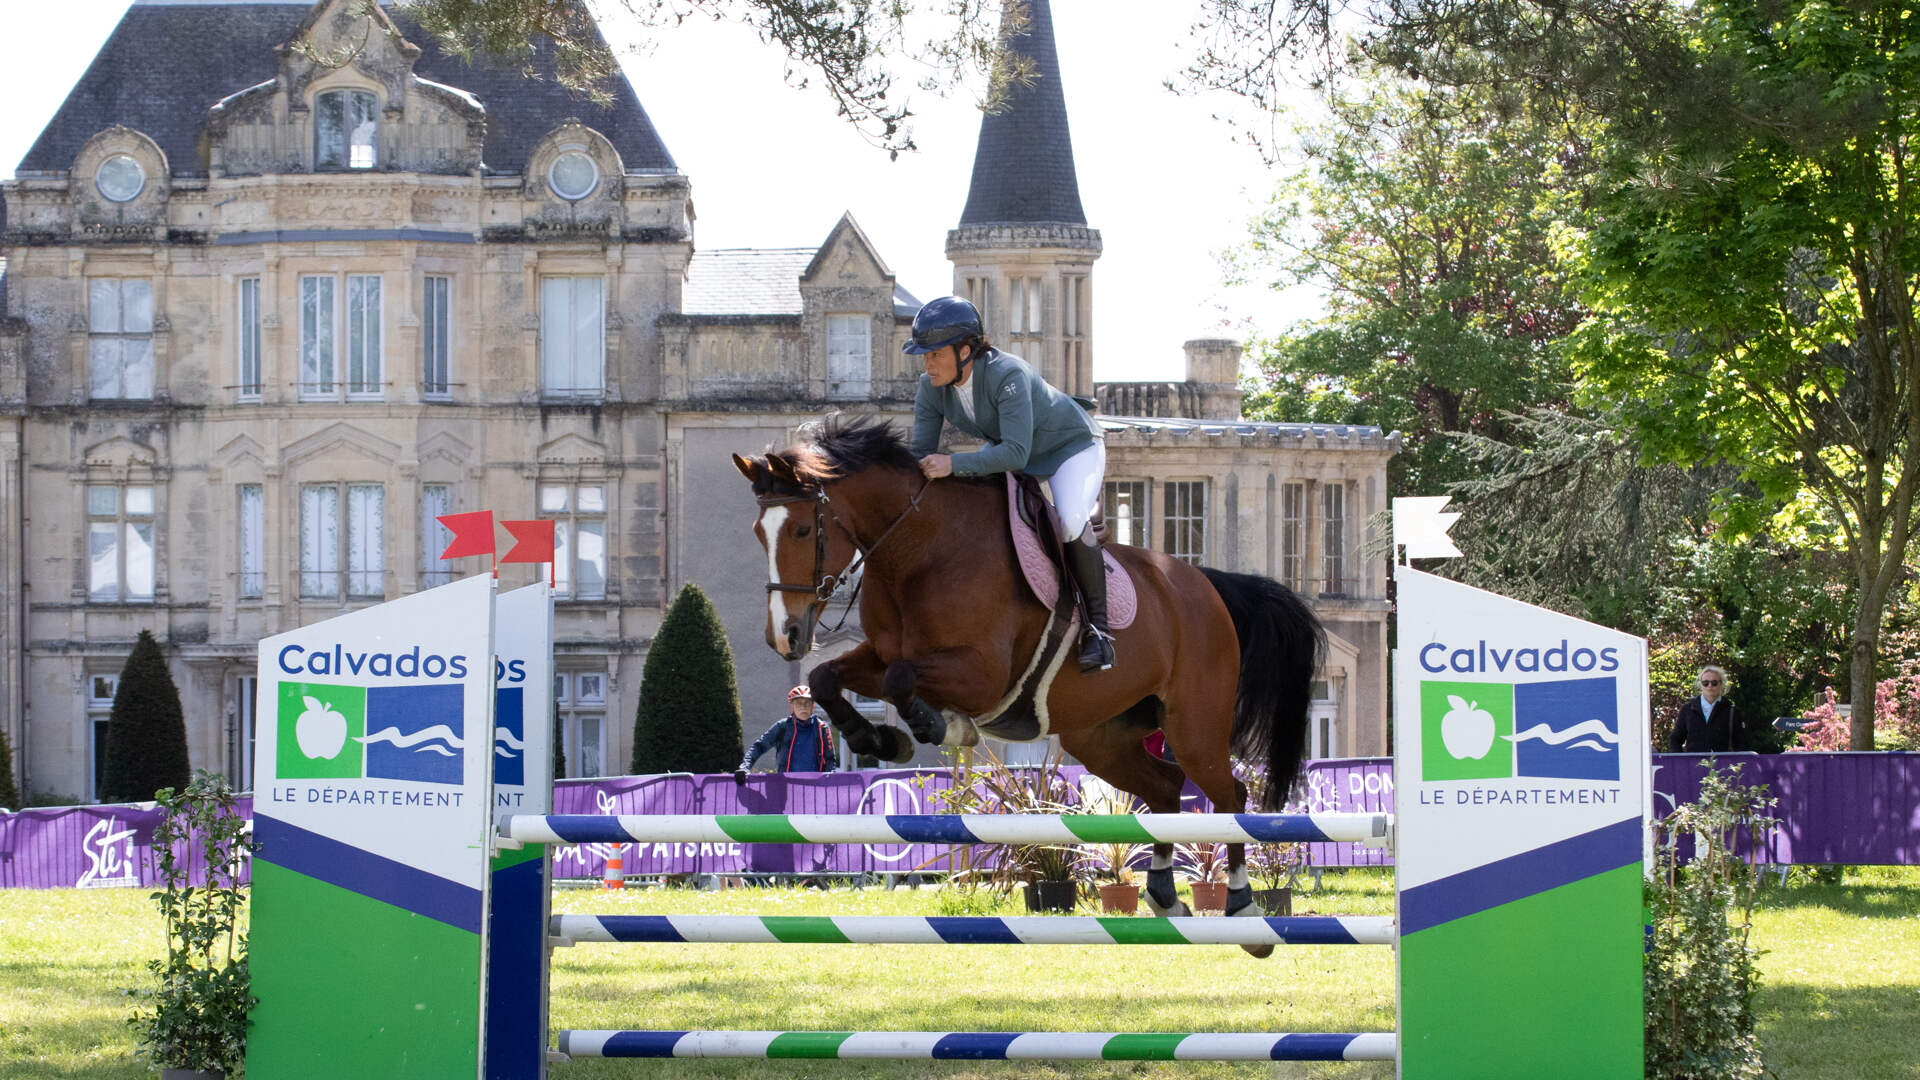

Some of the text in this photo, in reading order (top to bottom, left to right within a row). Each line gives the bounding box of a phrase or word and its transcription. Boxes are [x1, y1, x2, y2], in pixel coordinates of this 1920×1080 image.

[278, 644, 468, 678] Calvados
[1420, 640, 1619, 673] Calvados
[273, 786, 465, 807] LE DÉPARTEMENT
[1420, 786, 1621, 805] LE DÉPARTEMENT
